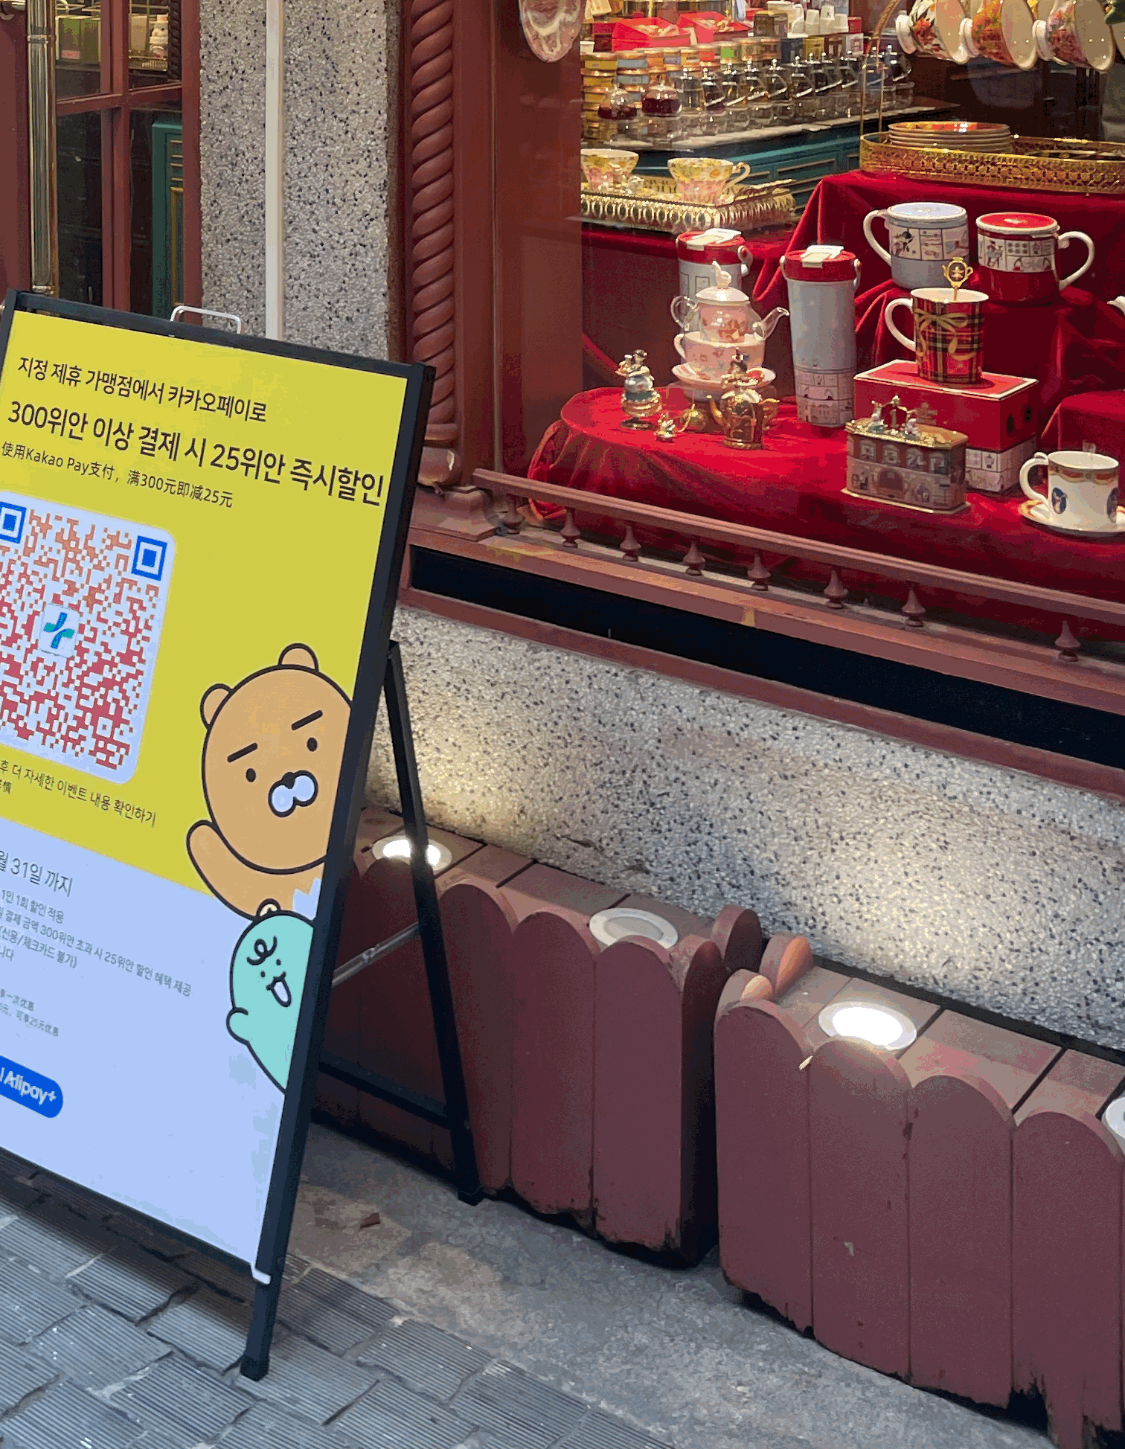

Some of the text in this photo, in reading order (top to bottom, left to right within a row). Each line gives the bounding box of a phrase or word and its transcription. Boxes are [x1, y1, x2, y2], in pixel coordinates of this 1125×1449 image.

[18, 356, 267, 422] 지정 제휴 가맹점에서 카카오페이로
[8, 400, 385, 506] 300위안 이상 결제 시 25위안 즉시할인
[0, 759, 10, 774] 후
[12, 764, 23, 779] 더
[24, 768, 56, 791] 자세한
[57, 779, 88, 801] 이벤트
[90, 791, 111, 811] 내용
[114, 799, 157, 828] 확인하기
[10, 857, 44, 885] 31일
[44, 869, 74, 897] 까지
[94, 946, 104, 960] 시
[4, 1070, 57, 1105] Alipay+
